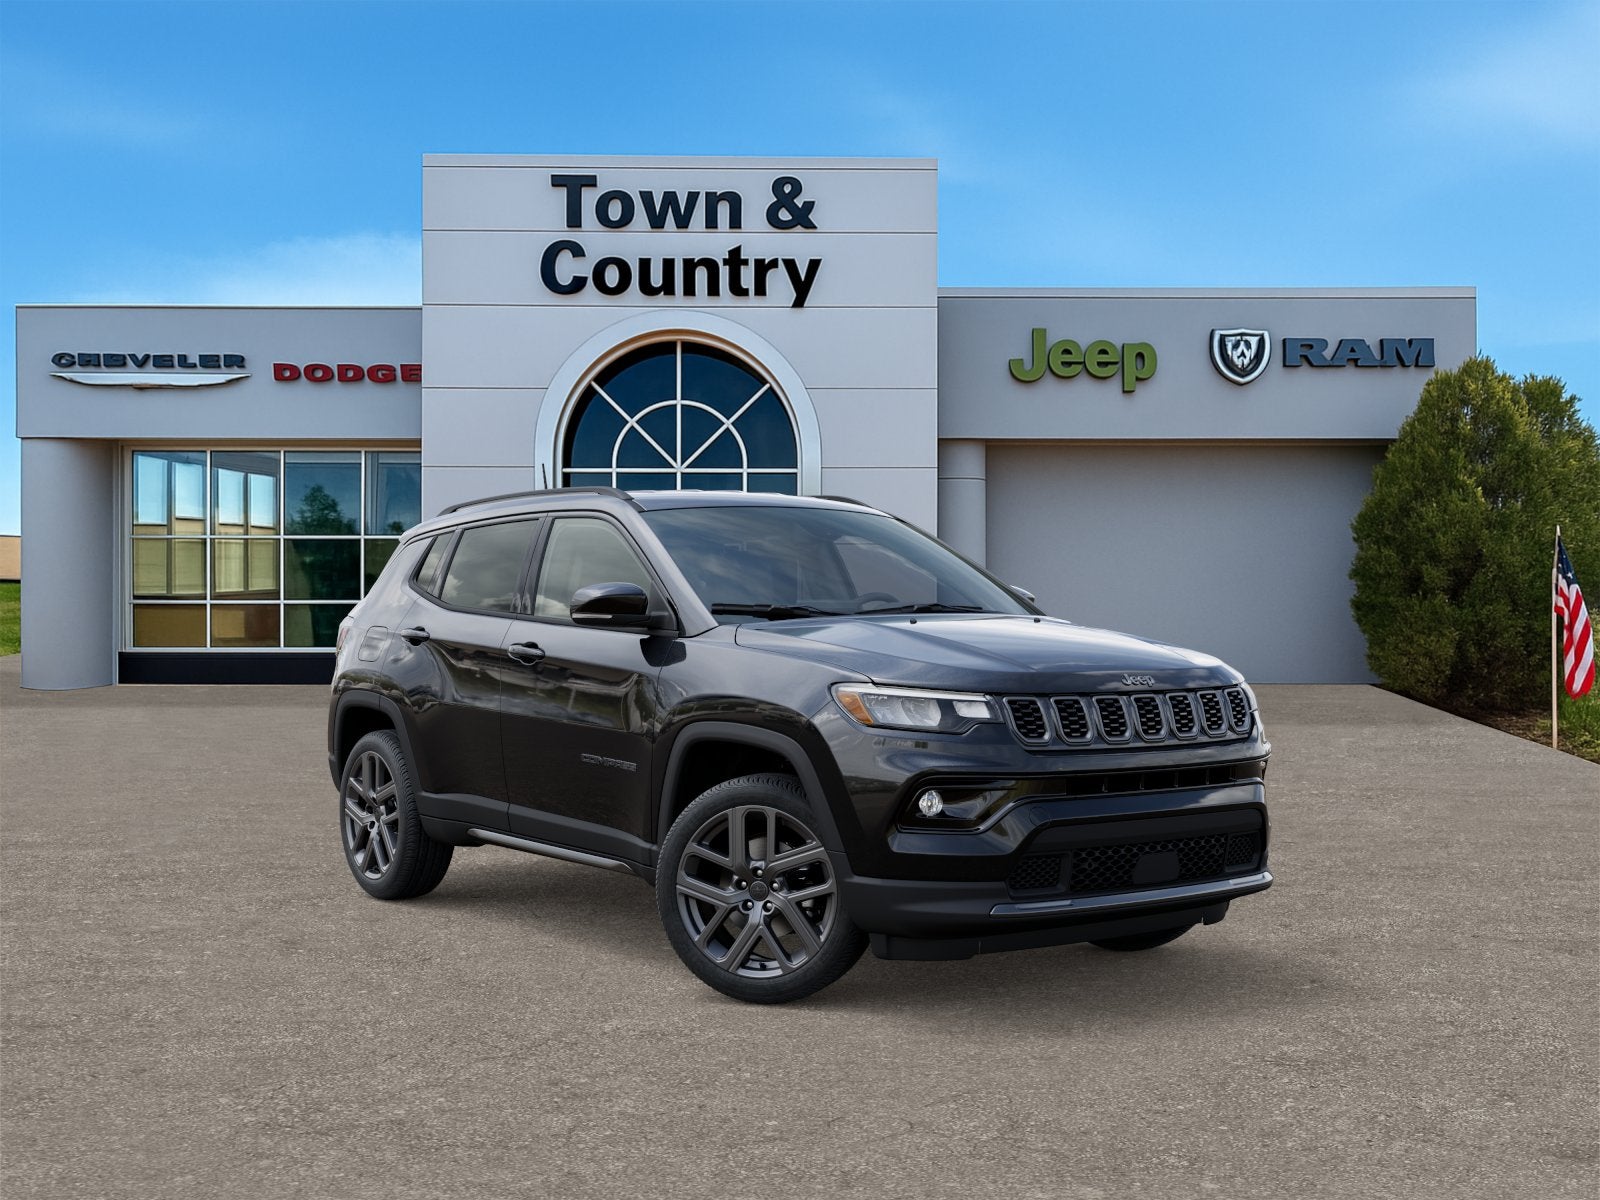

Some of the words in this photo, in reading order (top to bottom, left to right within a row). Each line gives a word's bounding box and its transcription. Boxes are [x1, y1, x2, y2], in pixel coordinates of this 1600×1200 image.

[551, 174, 743, 229] Town
[766, 176, 818, 229] &
[540, 239, 822, 307] Country
[273, 362, 422, 382] DODGE
[1009, 328, 1157, 393] Jeep
[1283, 338, 1435, 367] RAM
[1121, 673, 1155, 687] Jeep
